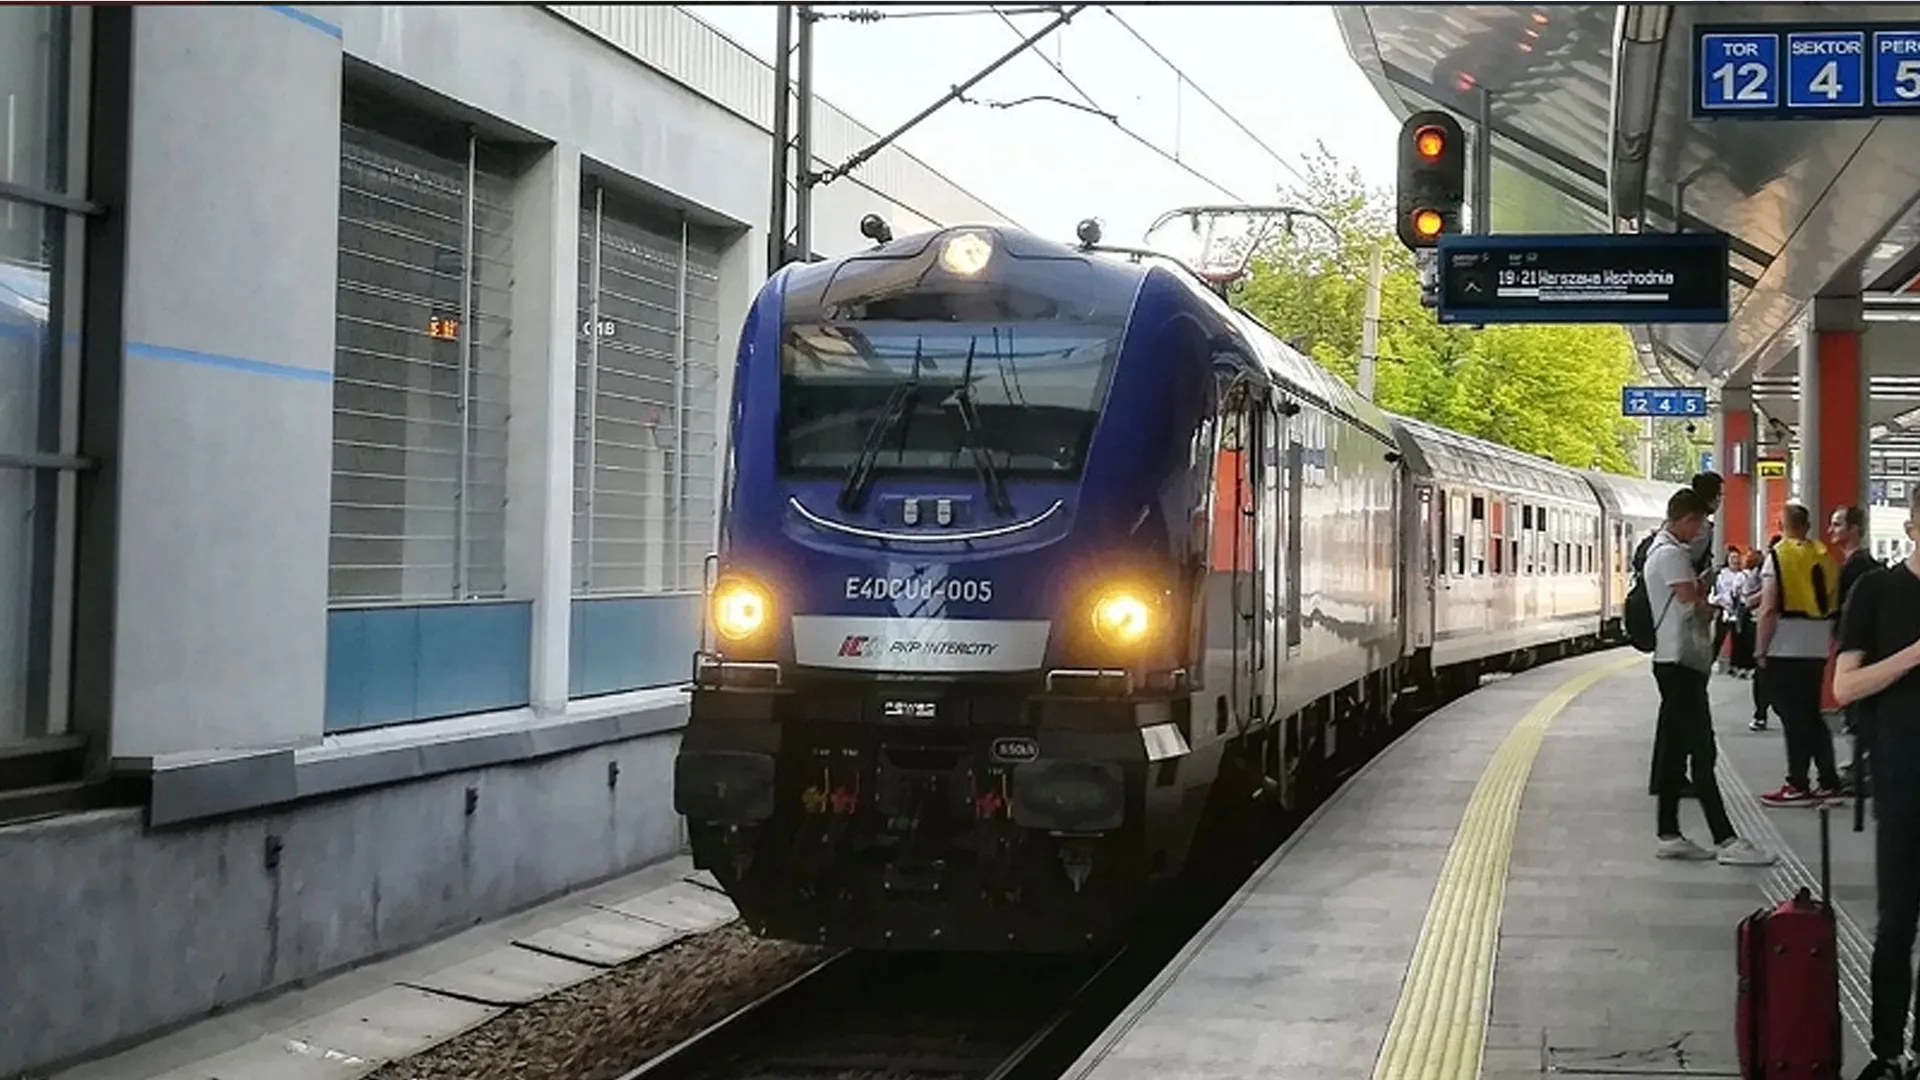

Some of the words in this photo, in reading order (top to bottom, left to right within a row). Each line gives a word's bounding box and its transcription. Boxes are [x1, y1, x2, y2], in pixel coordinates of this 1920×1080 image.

[1722, 42, 1758, 56] TOR
[1792, 40, 1862, 55] SEKTOR
[1880, 40, 1920, 54] PER
[1712, 62, 1768, 100] 12
[1808, 60, 1843, 99] 4
[1895, 60, 1920, 98] 5
[1603, 269, 1674, 285] Wschodnia
[1629, 399, 1648, 413] 12
[1659, 398, 1672, 412] 4
[1686, 399, 1697, 412] 5
[845, 577, 992, 601] E4DCUd-005
